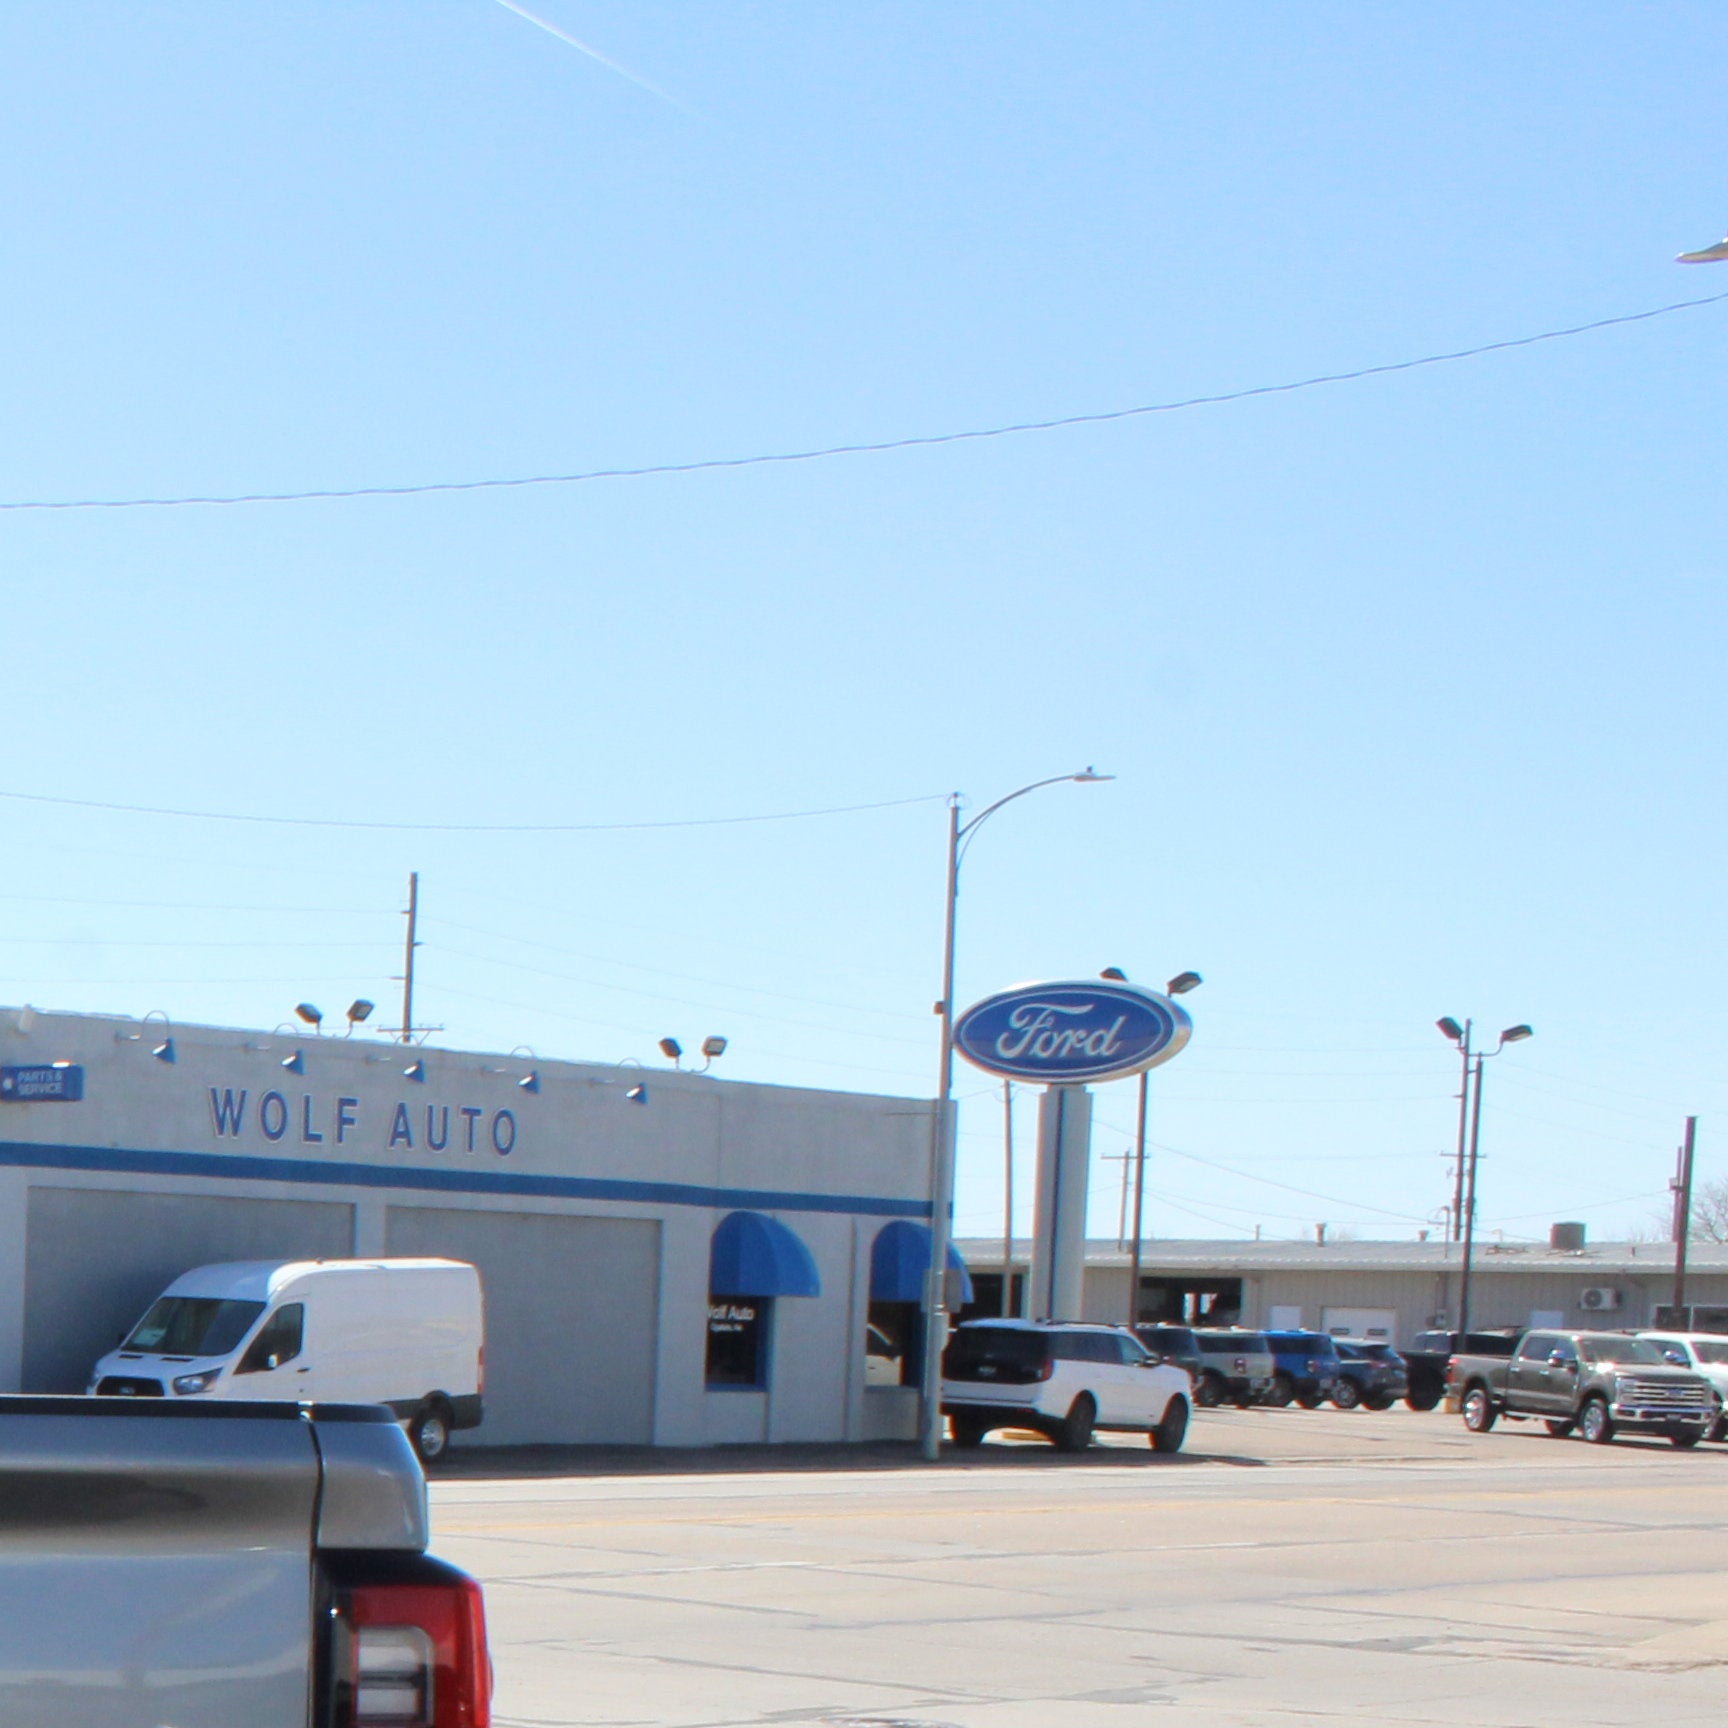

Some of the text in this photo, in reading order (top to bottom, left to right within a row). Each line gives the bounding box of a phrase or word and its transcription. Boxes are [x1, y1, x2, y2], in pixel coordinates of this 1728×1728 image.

[997, 1003, 1127, 1058] Ford
[18, 1071, 53, 1083] PARTS
[18, 1083, 63, 1096] SERVICE
[209, 1086, 517, 1157] WOLF AUTO
